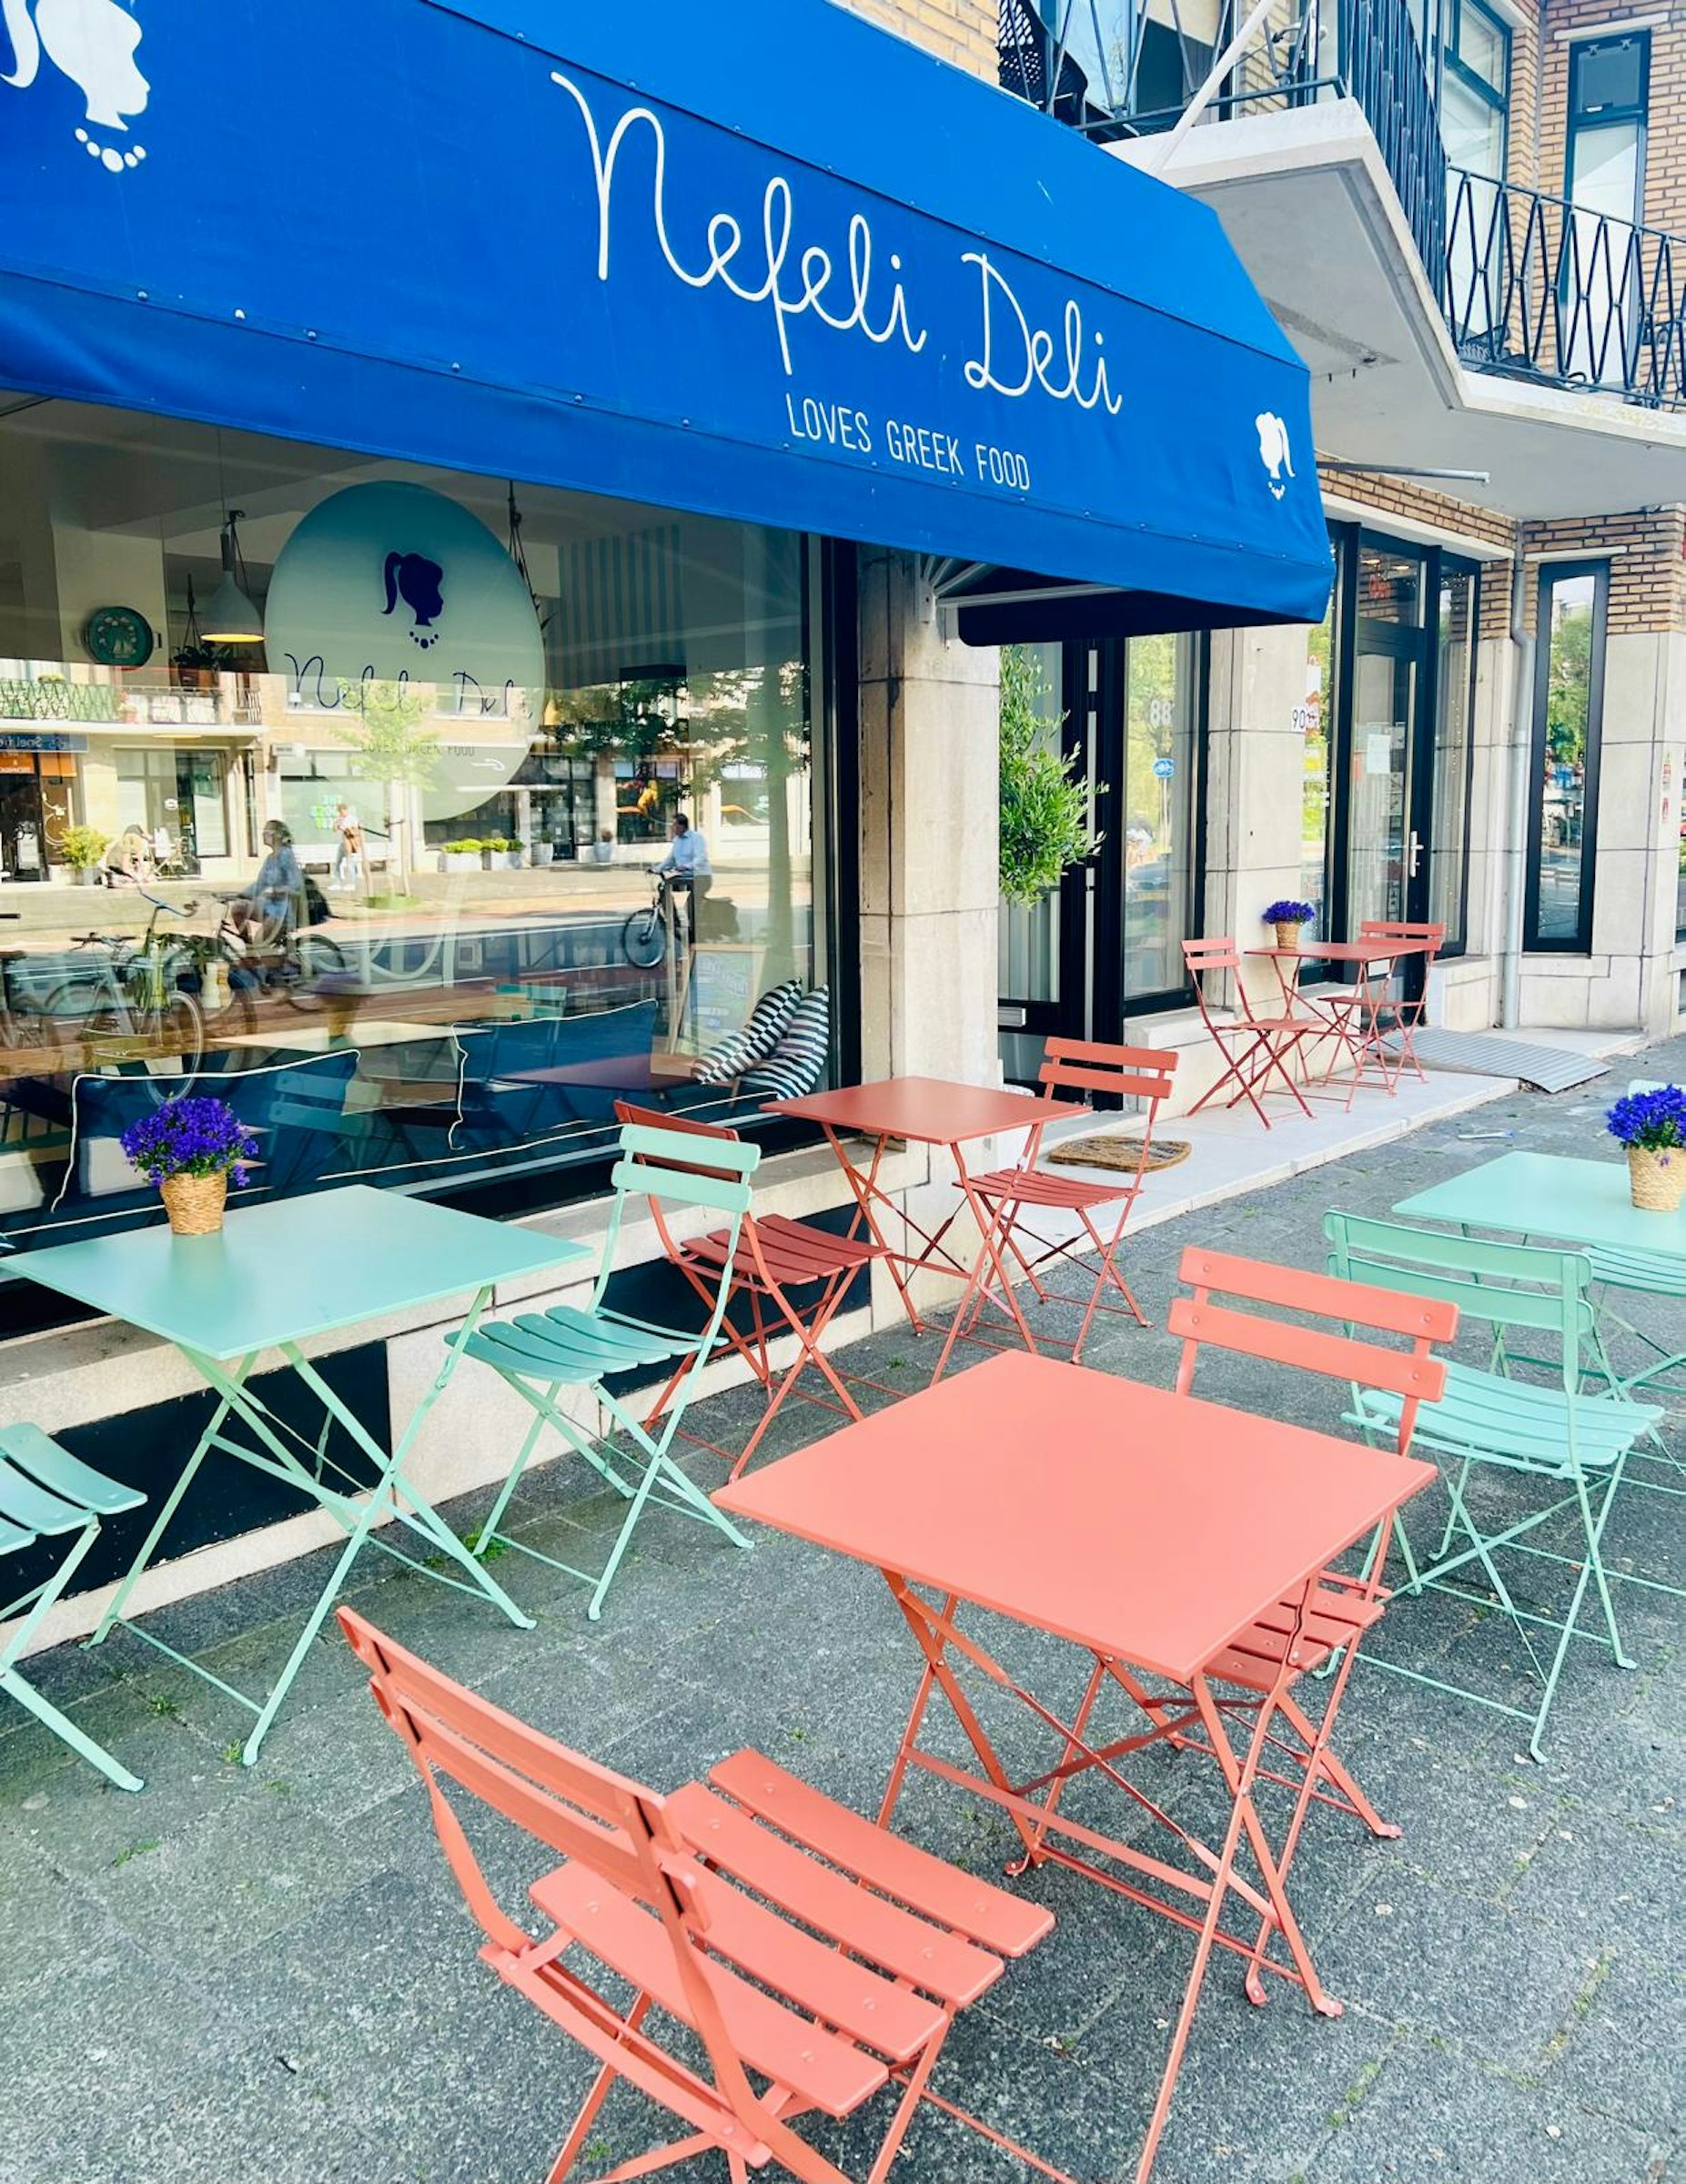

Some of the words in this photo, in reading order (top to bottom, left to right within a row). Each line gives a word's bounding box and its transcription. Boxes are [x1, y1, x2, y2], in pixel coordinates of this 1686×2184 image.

[961, 252, 1123, 415] Deli
[786, 393, 872, 452] LOVES
[886, 420, 964, 475] GREEK
[975, 444, 1030, 490] FOOD
[1150, 699, 1171, 728] 88
